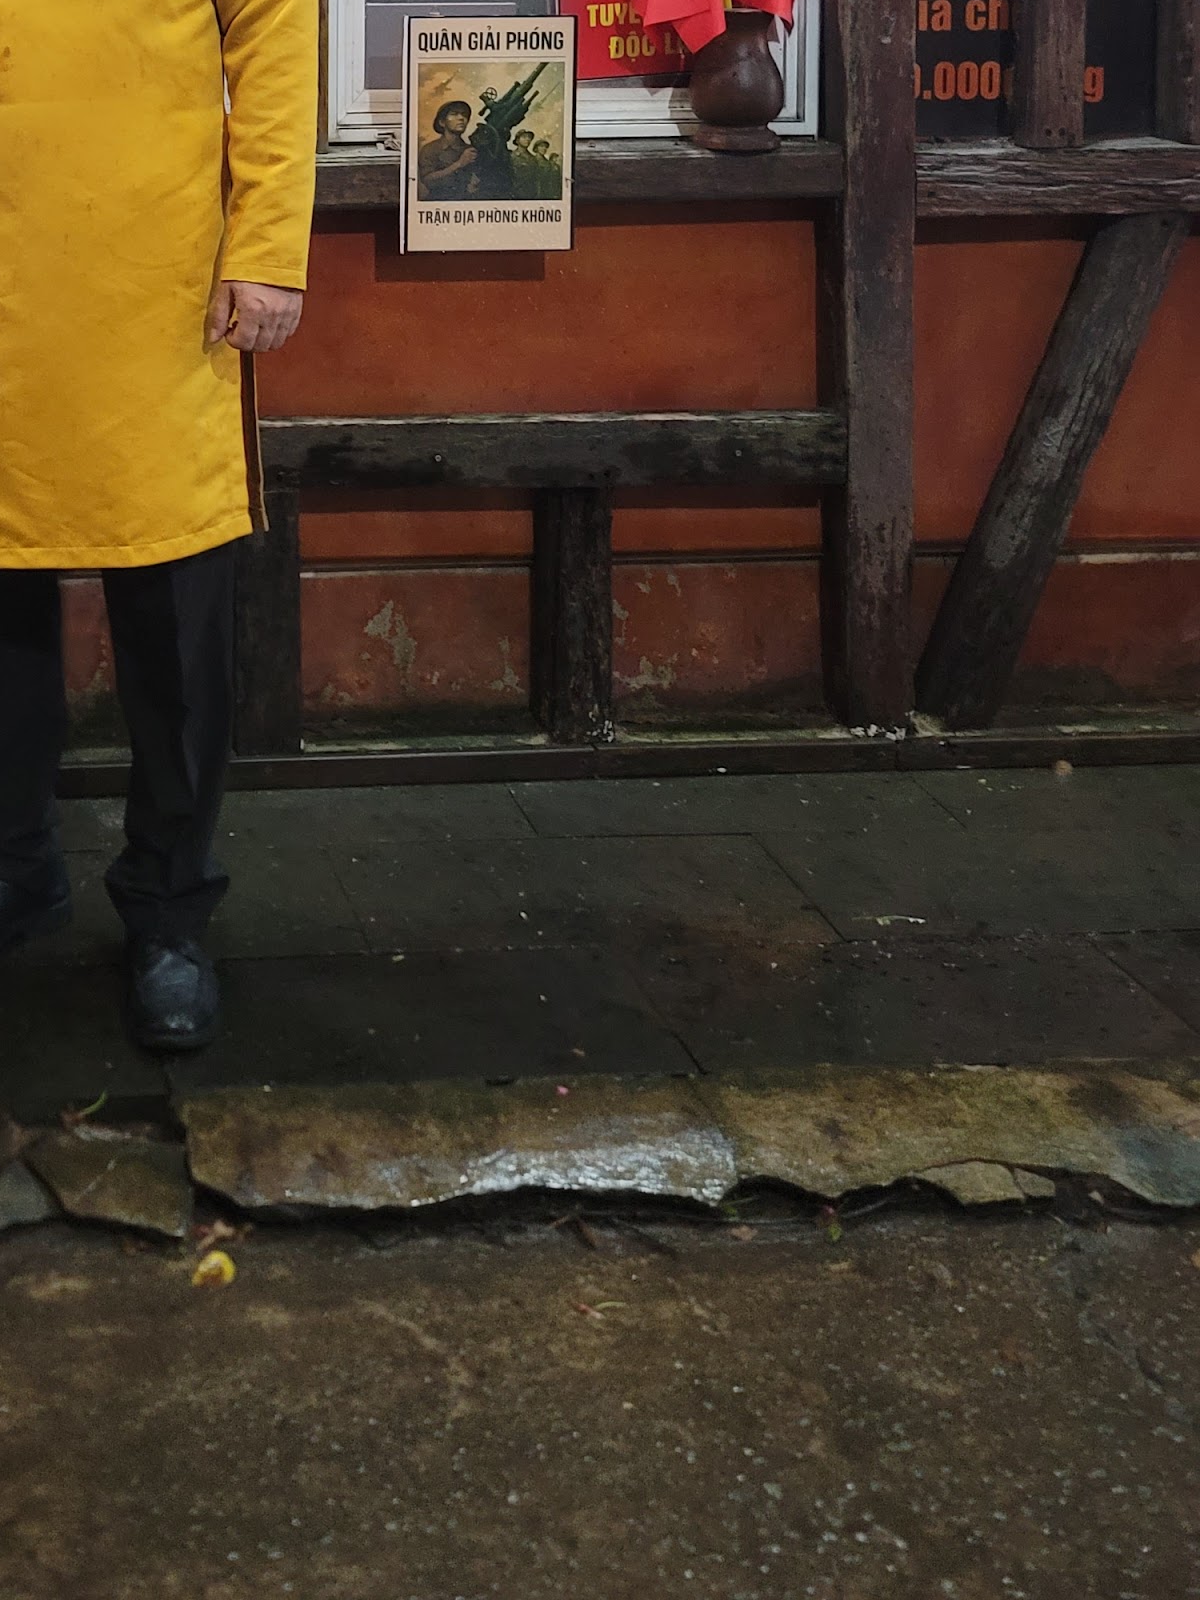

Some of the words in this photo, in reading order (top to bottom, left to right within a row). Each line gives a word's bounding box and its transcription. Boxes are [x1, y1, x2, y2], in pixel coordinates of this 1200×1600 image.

[418, 29, 462, 52] QUÂN
[468, 26, 500, 50] GIẢI
[506, 27, 564, 50] PHÓNG
[418, 211, 450, 226] TRẬN
[454, 211, 474, 226] ĐỊA
[478, 208, 518, 223] PHÒNG
[522, 207, 562, 223] KHÔNG
